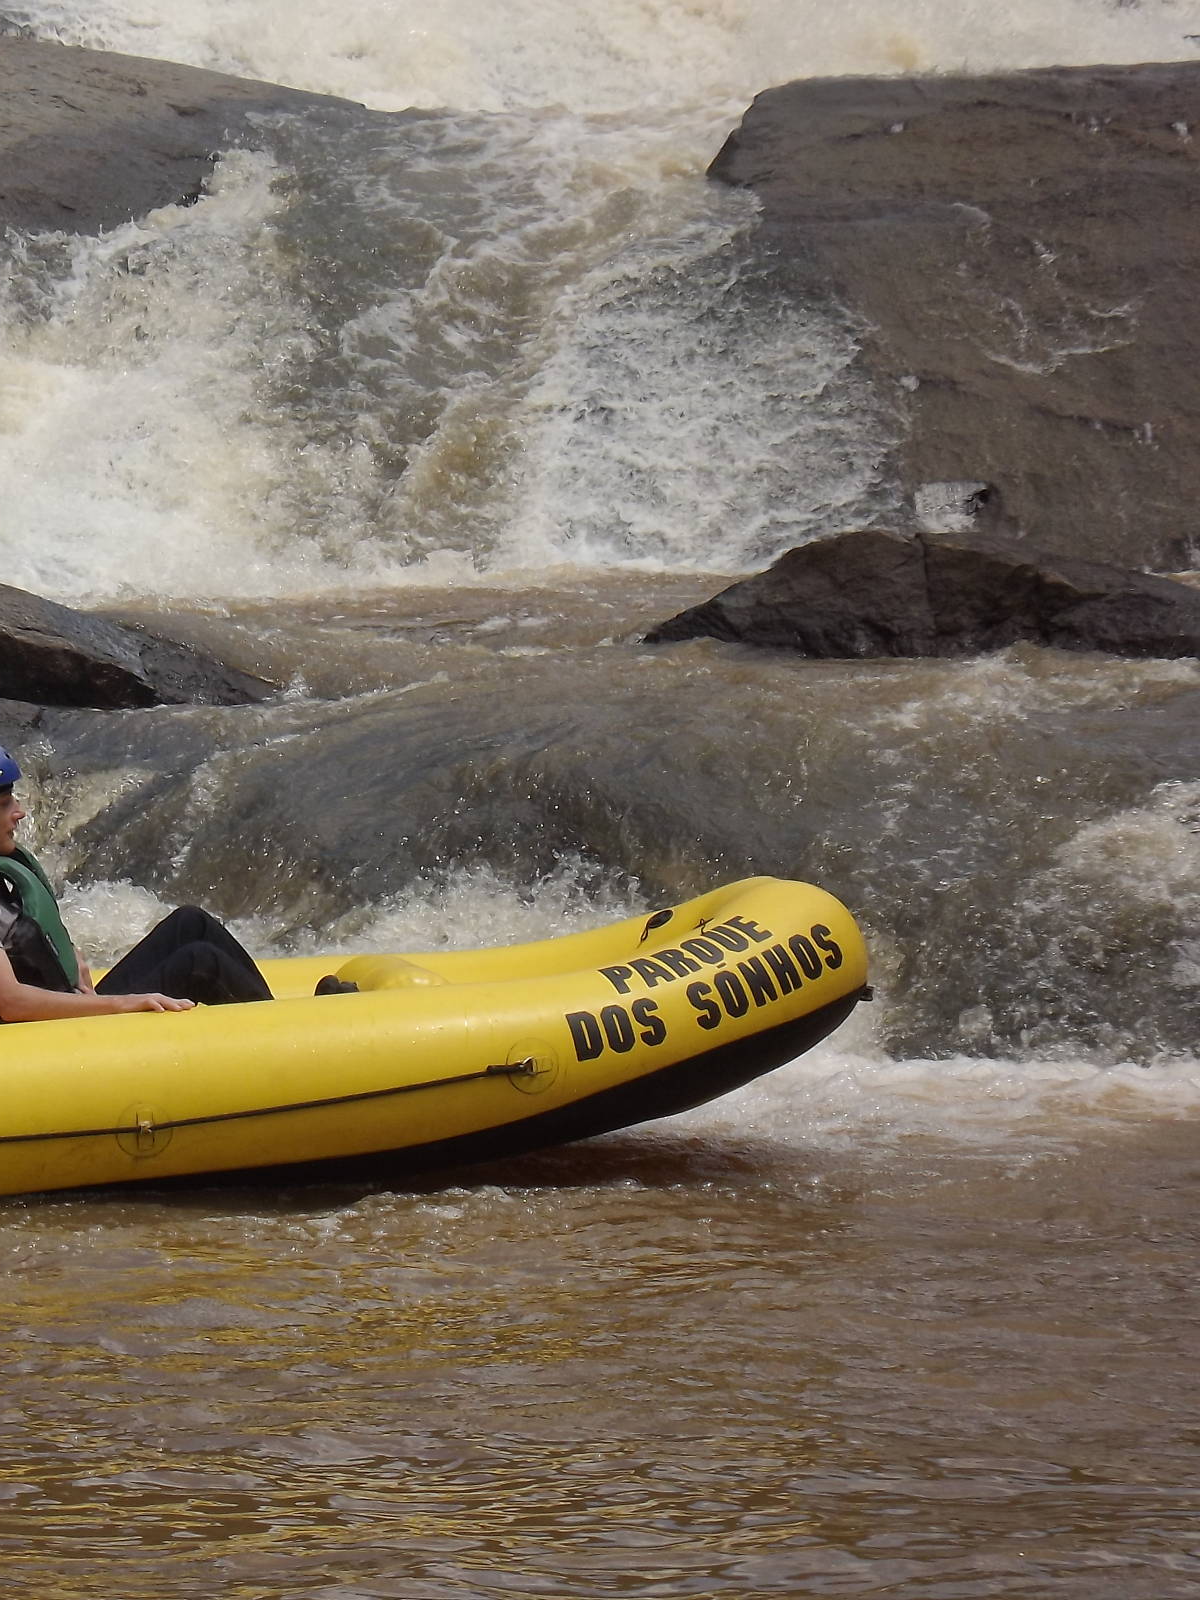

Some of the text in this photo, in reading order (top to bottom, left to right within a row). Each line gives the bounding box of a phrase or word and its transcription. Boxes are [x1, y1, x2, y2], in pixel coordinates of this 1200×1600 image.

[565, 923, 843, 1062] DOS SONHOS
[598, 915, 773, 994] PARQUE
